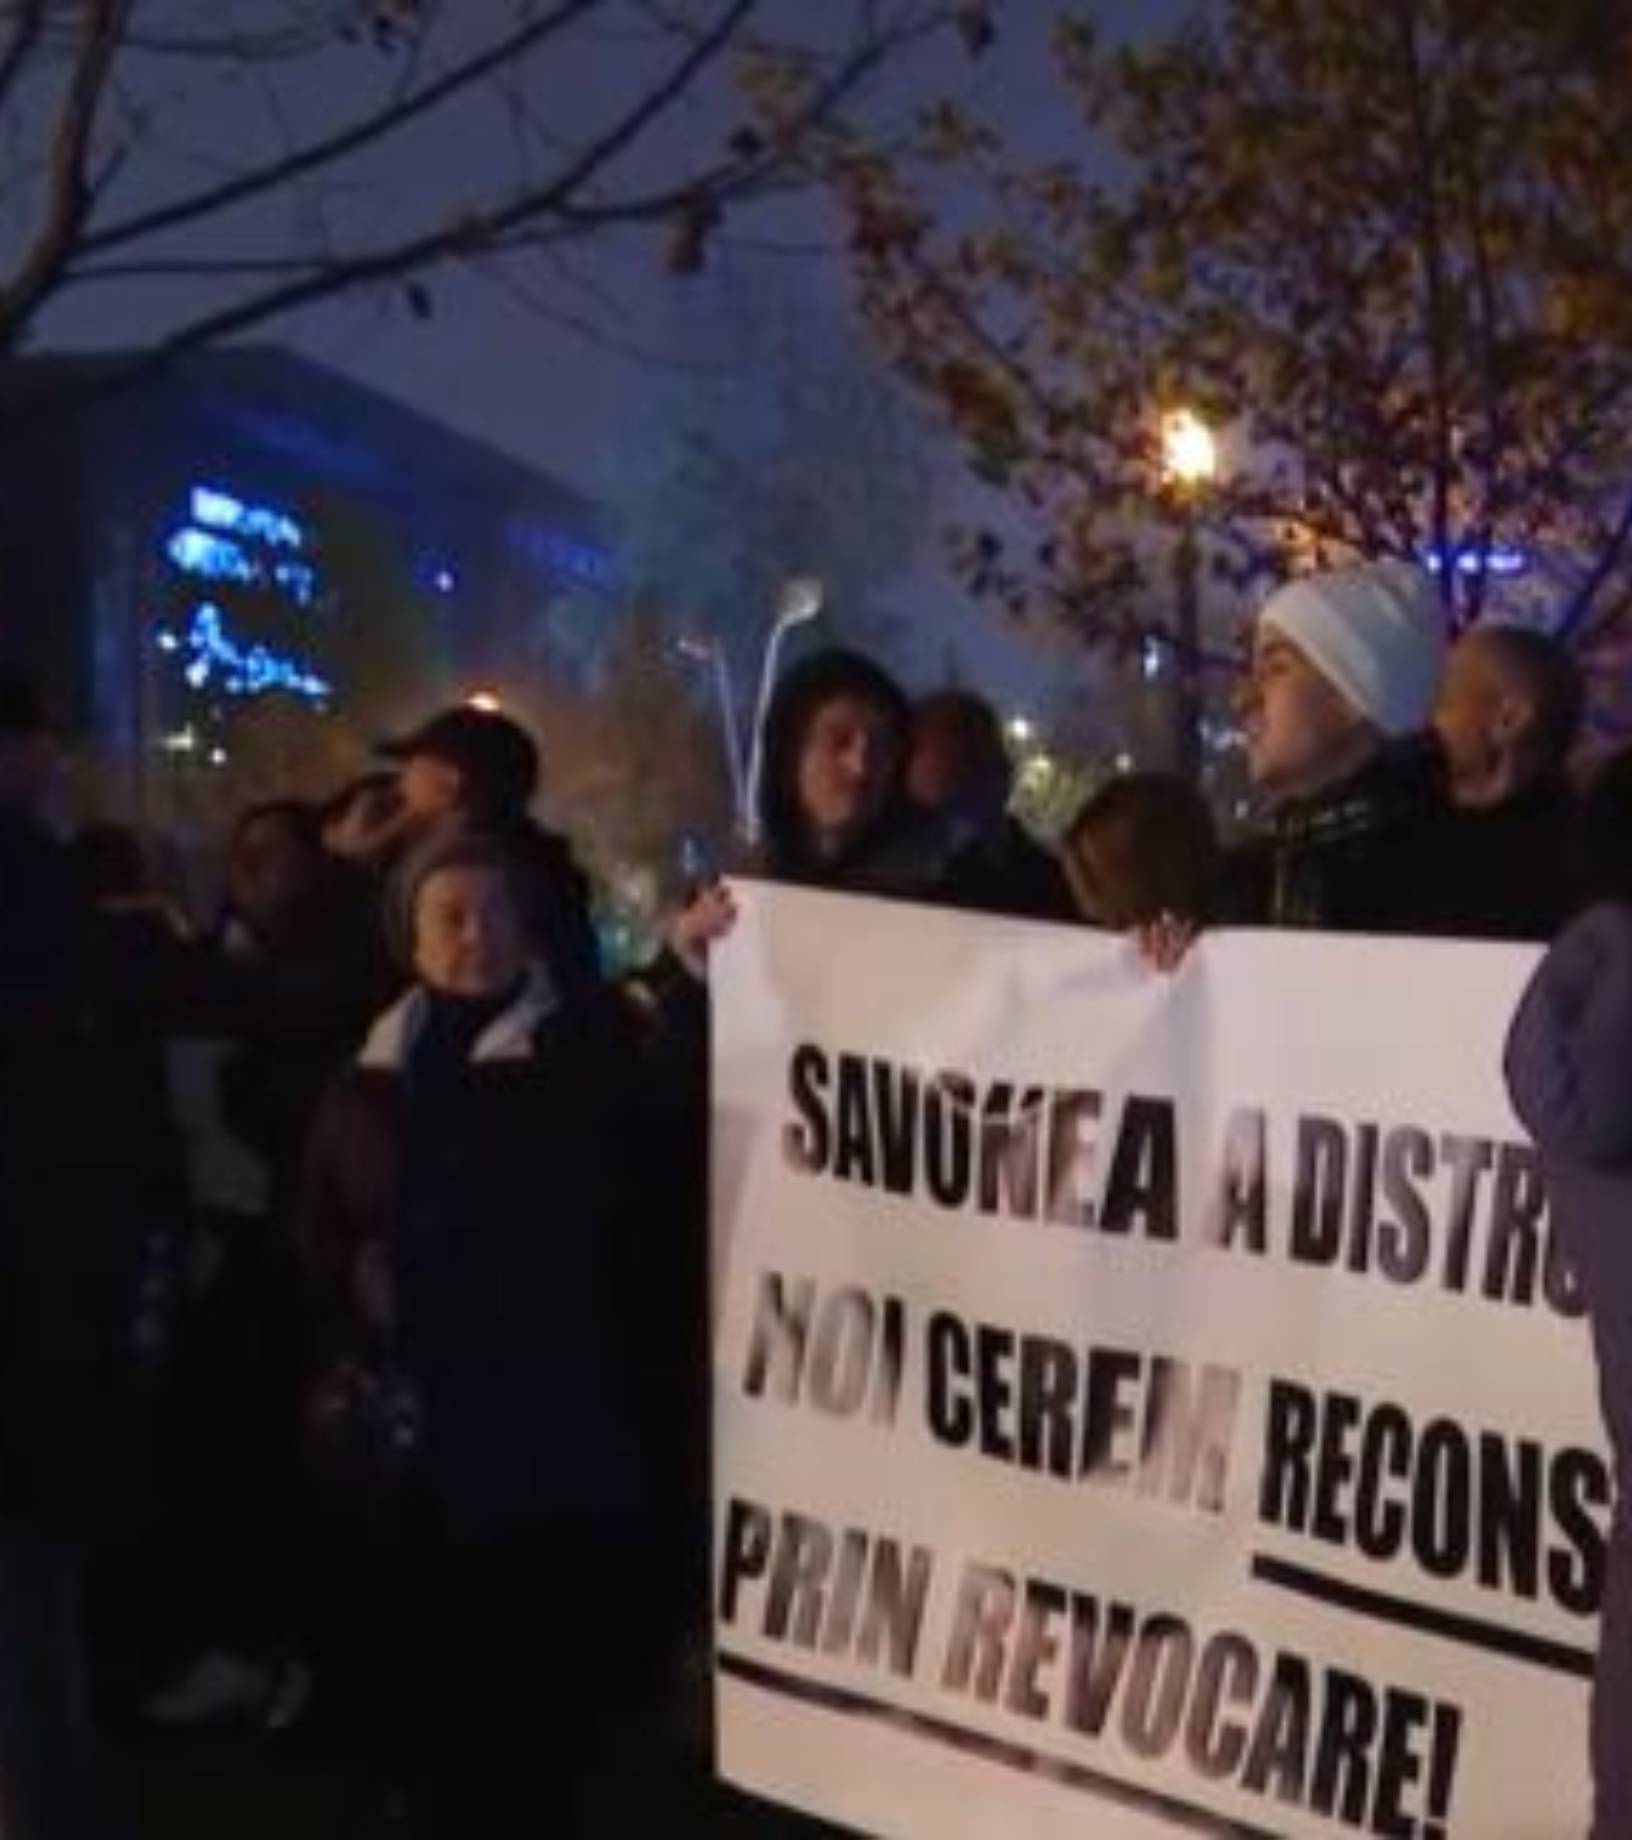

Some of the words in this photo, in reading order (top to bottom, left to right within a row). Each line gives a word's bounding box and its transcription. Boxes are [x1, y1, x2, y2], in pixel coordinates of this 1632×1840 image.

[780, 1044, 1181, 1242] SAVONEA
[1214, 1106, 1267, 1257] A
[741, 1270, 906, 1429] NOI
[924, 1310, 1243, 1516] CEREM
[717, 1498, 934, 1680] PRIN
[941, 1563, 1463, 1840] REVOCARE!
